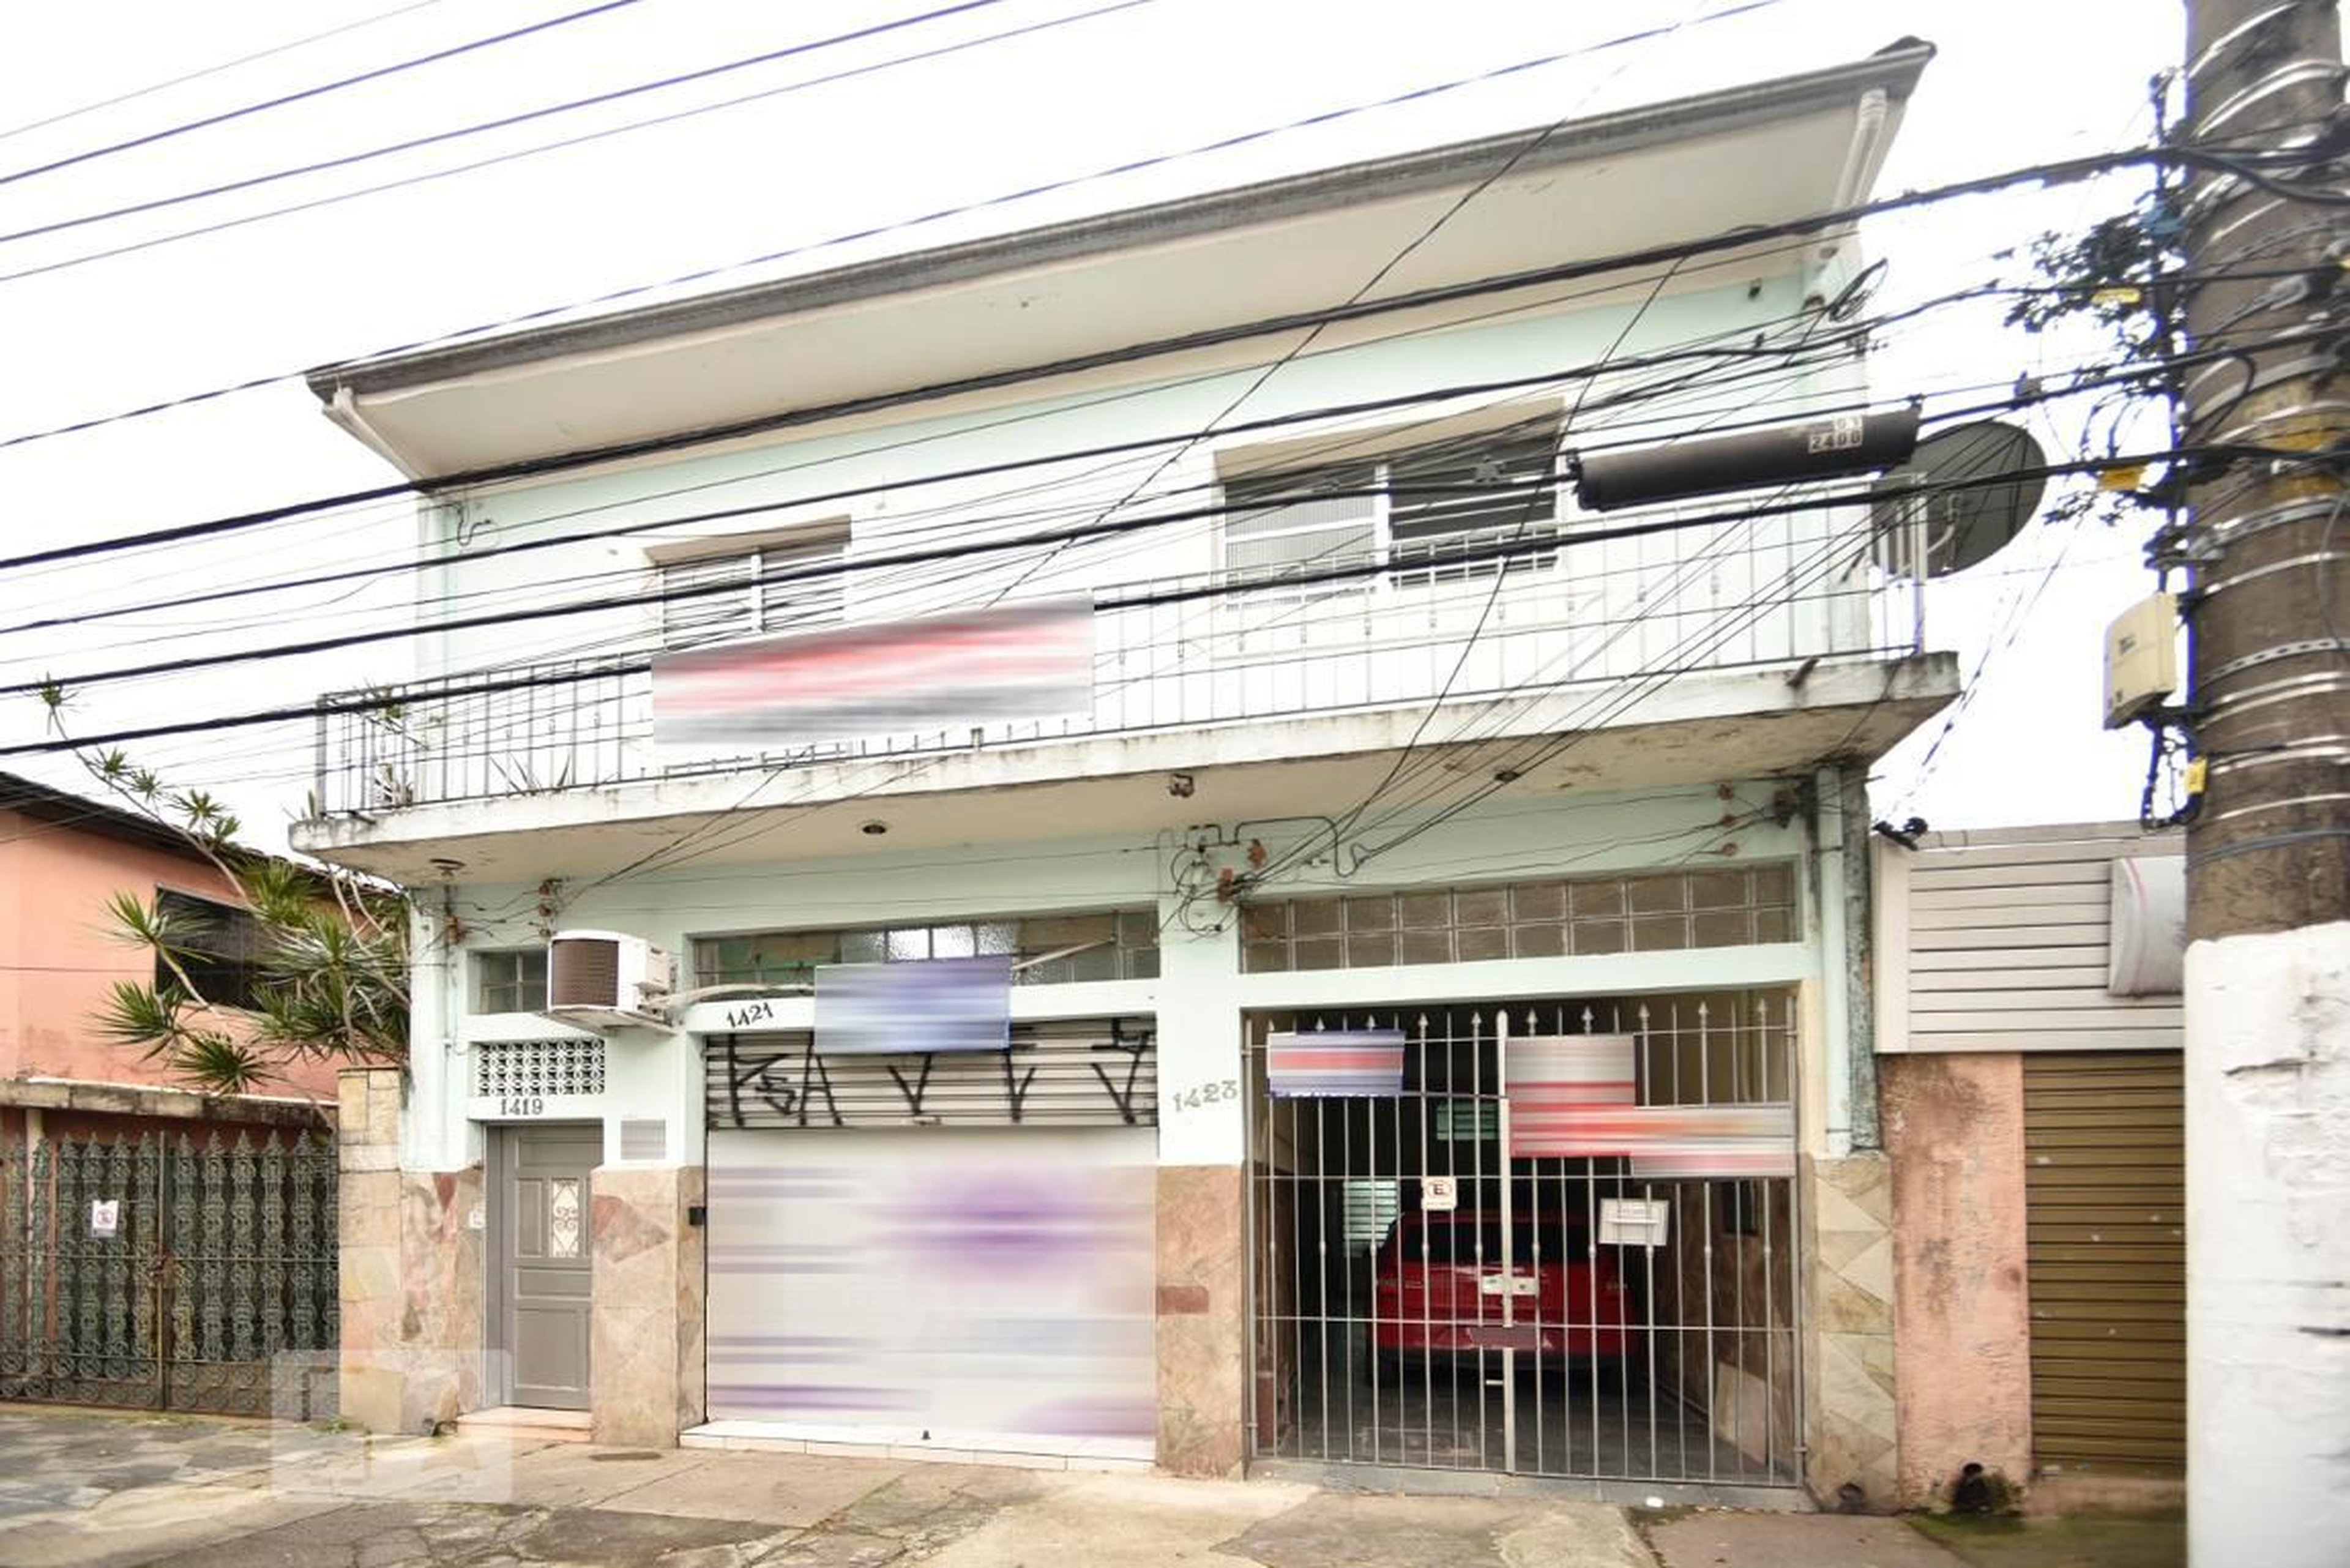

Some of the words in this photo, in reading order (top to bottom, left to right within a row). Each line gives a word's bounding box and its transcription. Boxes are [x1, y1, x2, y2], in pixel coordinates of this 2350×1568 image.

[726, 1002, 774, 1028] 1421
[500, 1099, 544, 1115] 1419
[1173, 1080, 1237, 1113] 1423
